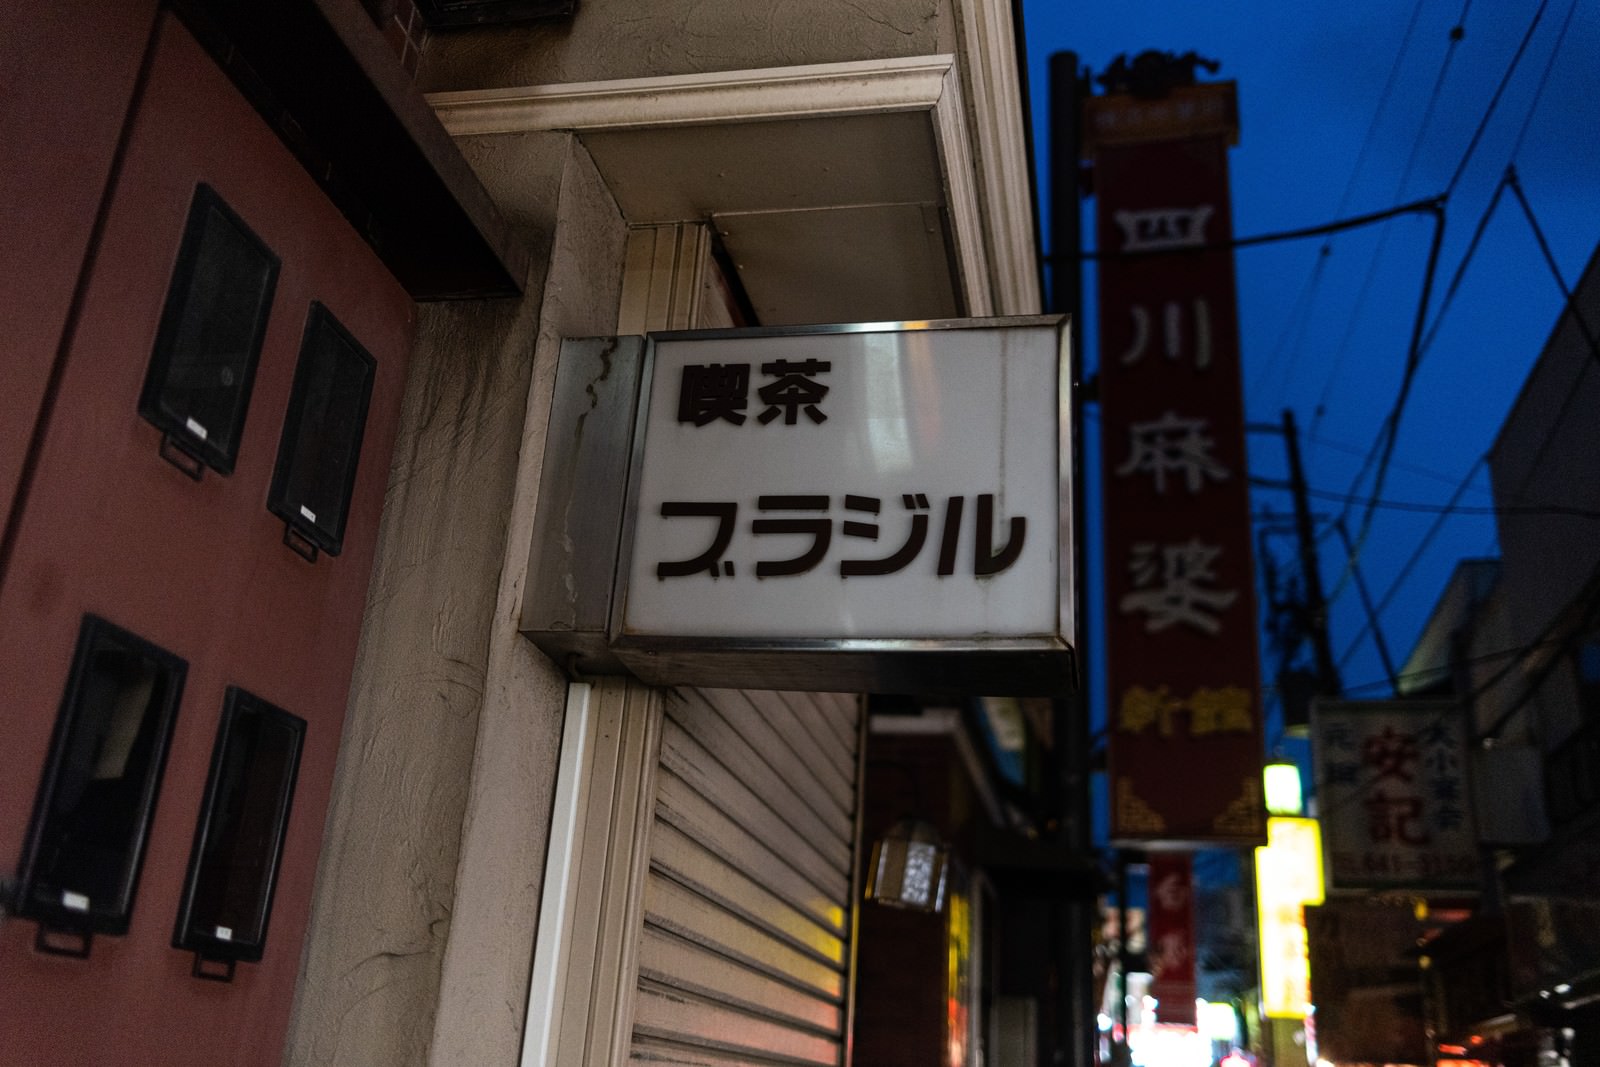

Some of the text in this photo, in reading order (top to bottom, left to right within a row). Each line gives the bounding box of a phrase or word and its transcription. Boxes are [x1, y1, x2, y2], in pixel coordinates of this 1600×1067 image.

[677, 358, 832, 427] 喫茶
[1113, 205, 1239, 636] 四川麻婆
[657, 494, 1026, 577] ブラジル
[1363, 725, 1431, 846] 安記
